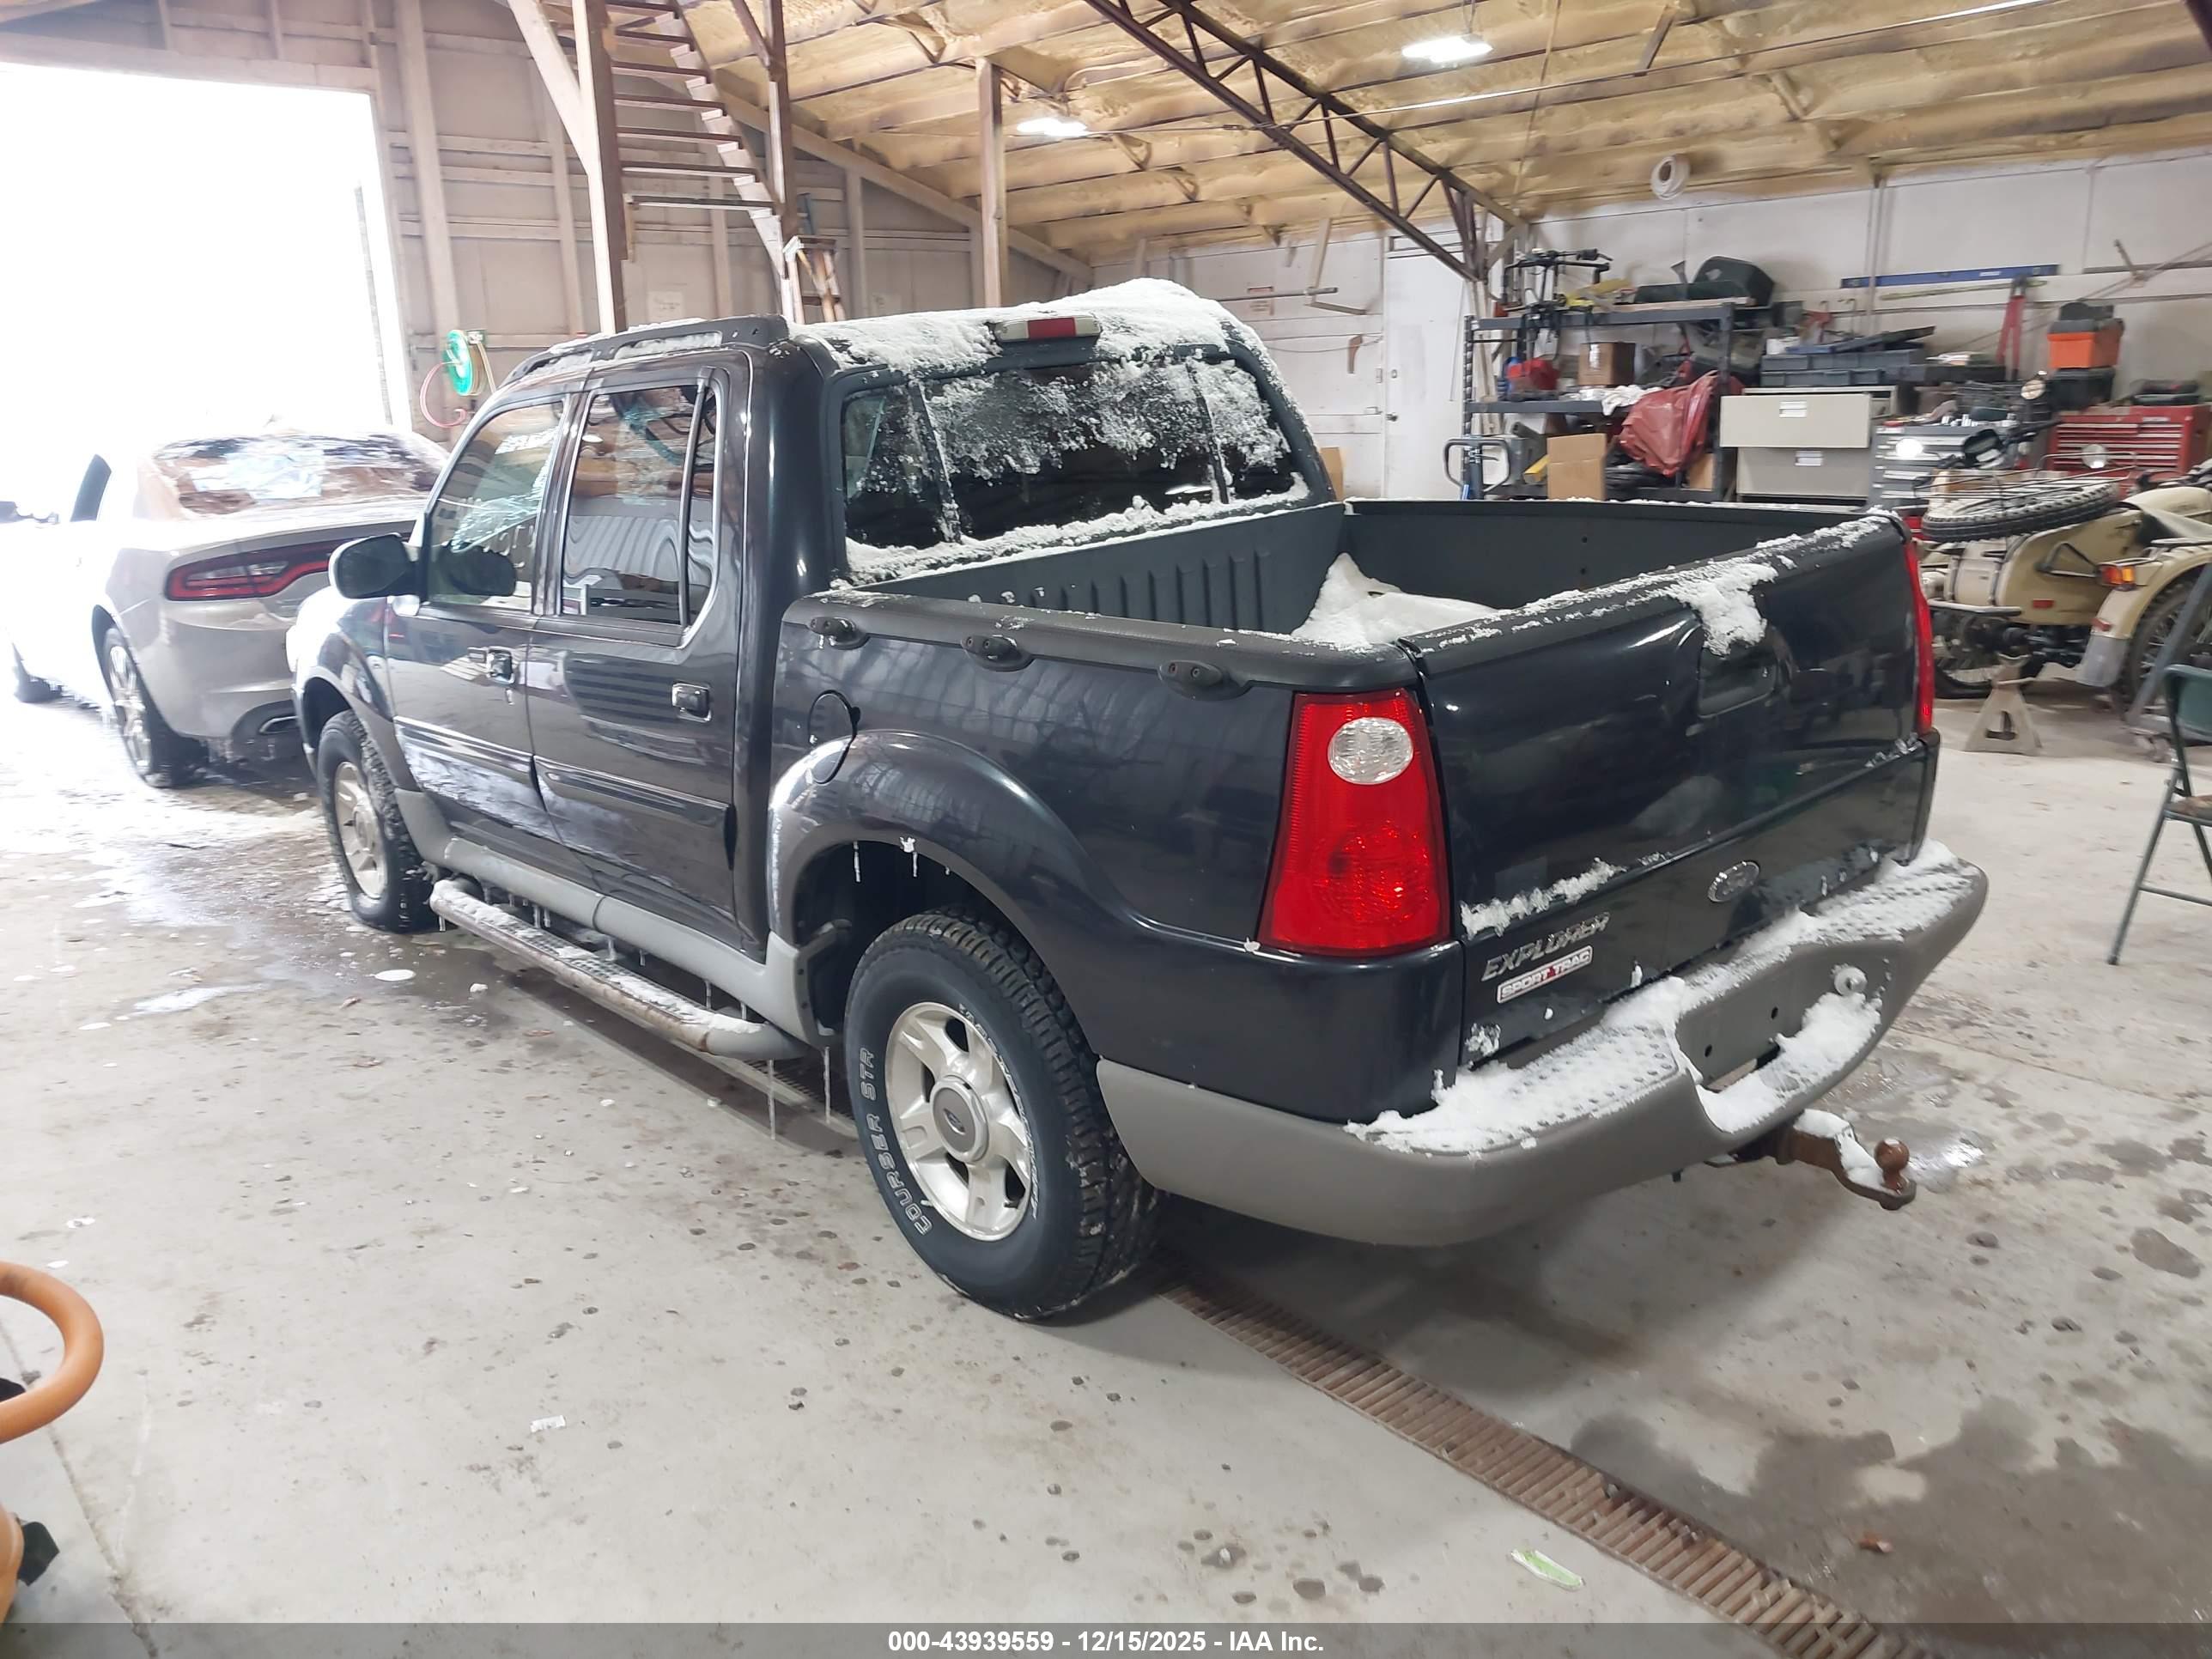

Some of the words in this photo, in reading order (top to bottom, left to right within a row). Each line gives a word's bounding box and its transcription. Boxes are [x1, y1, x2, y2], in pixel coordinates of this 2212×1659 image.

[1481, 911, 1611, 981] EXPLORER
[1501, 968, 1551, 998] SPORT
[1552, 950, 1590, 975] TRAC
[860, 1047, 877, 1101] STR
[866, 1113, 933, 1237] COURSER
